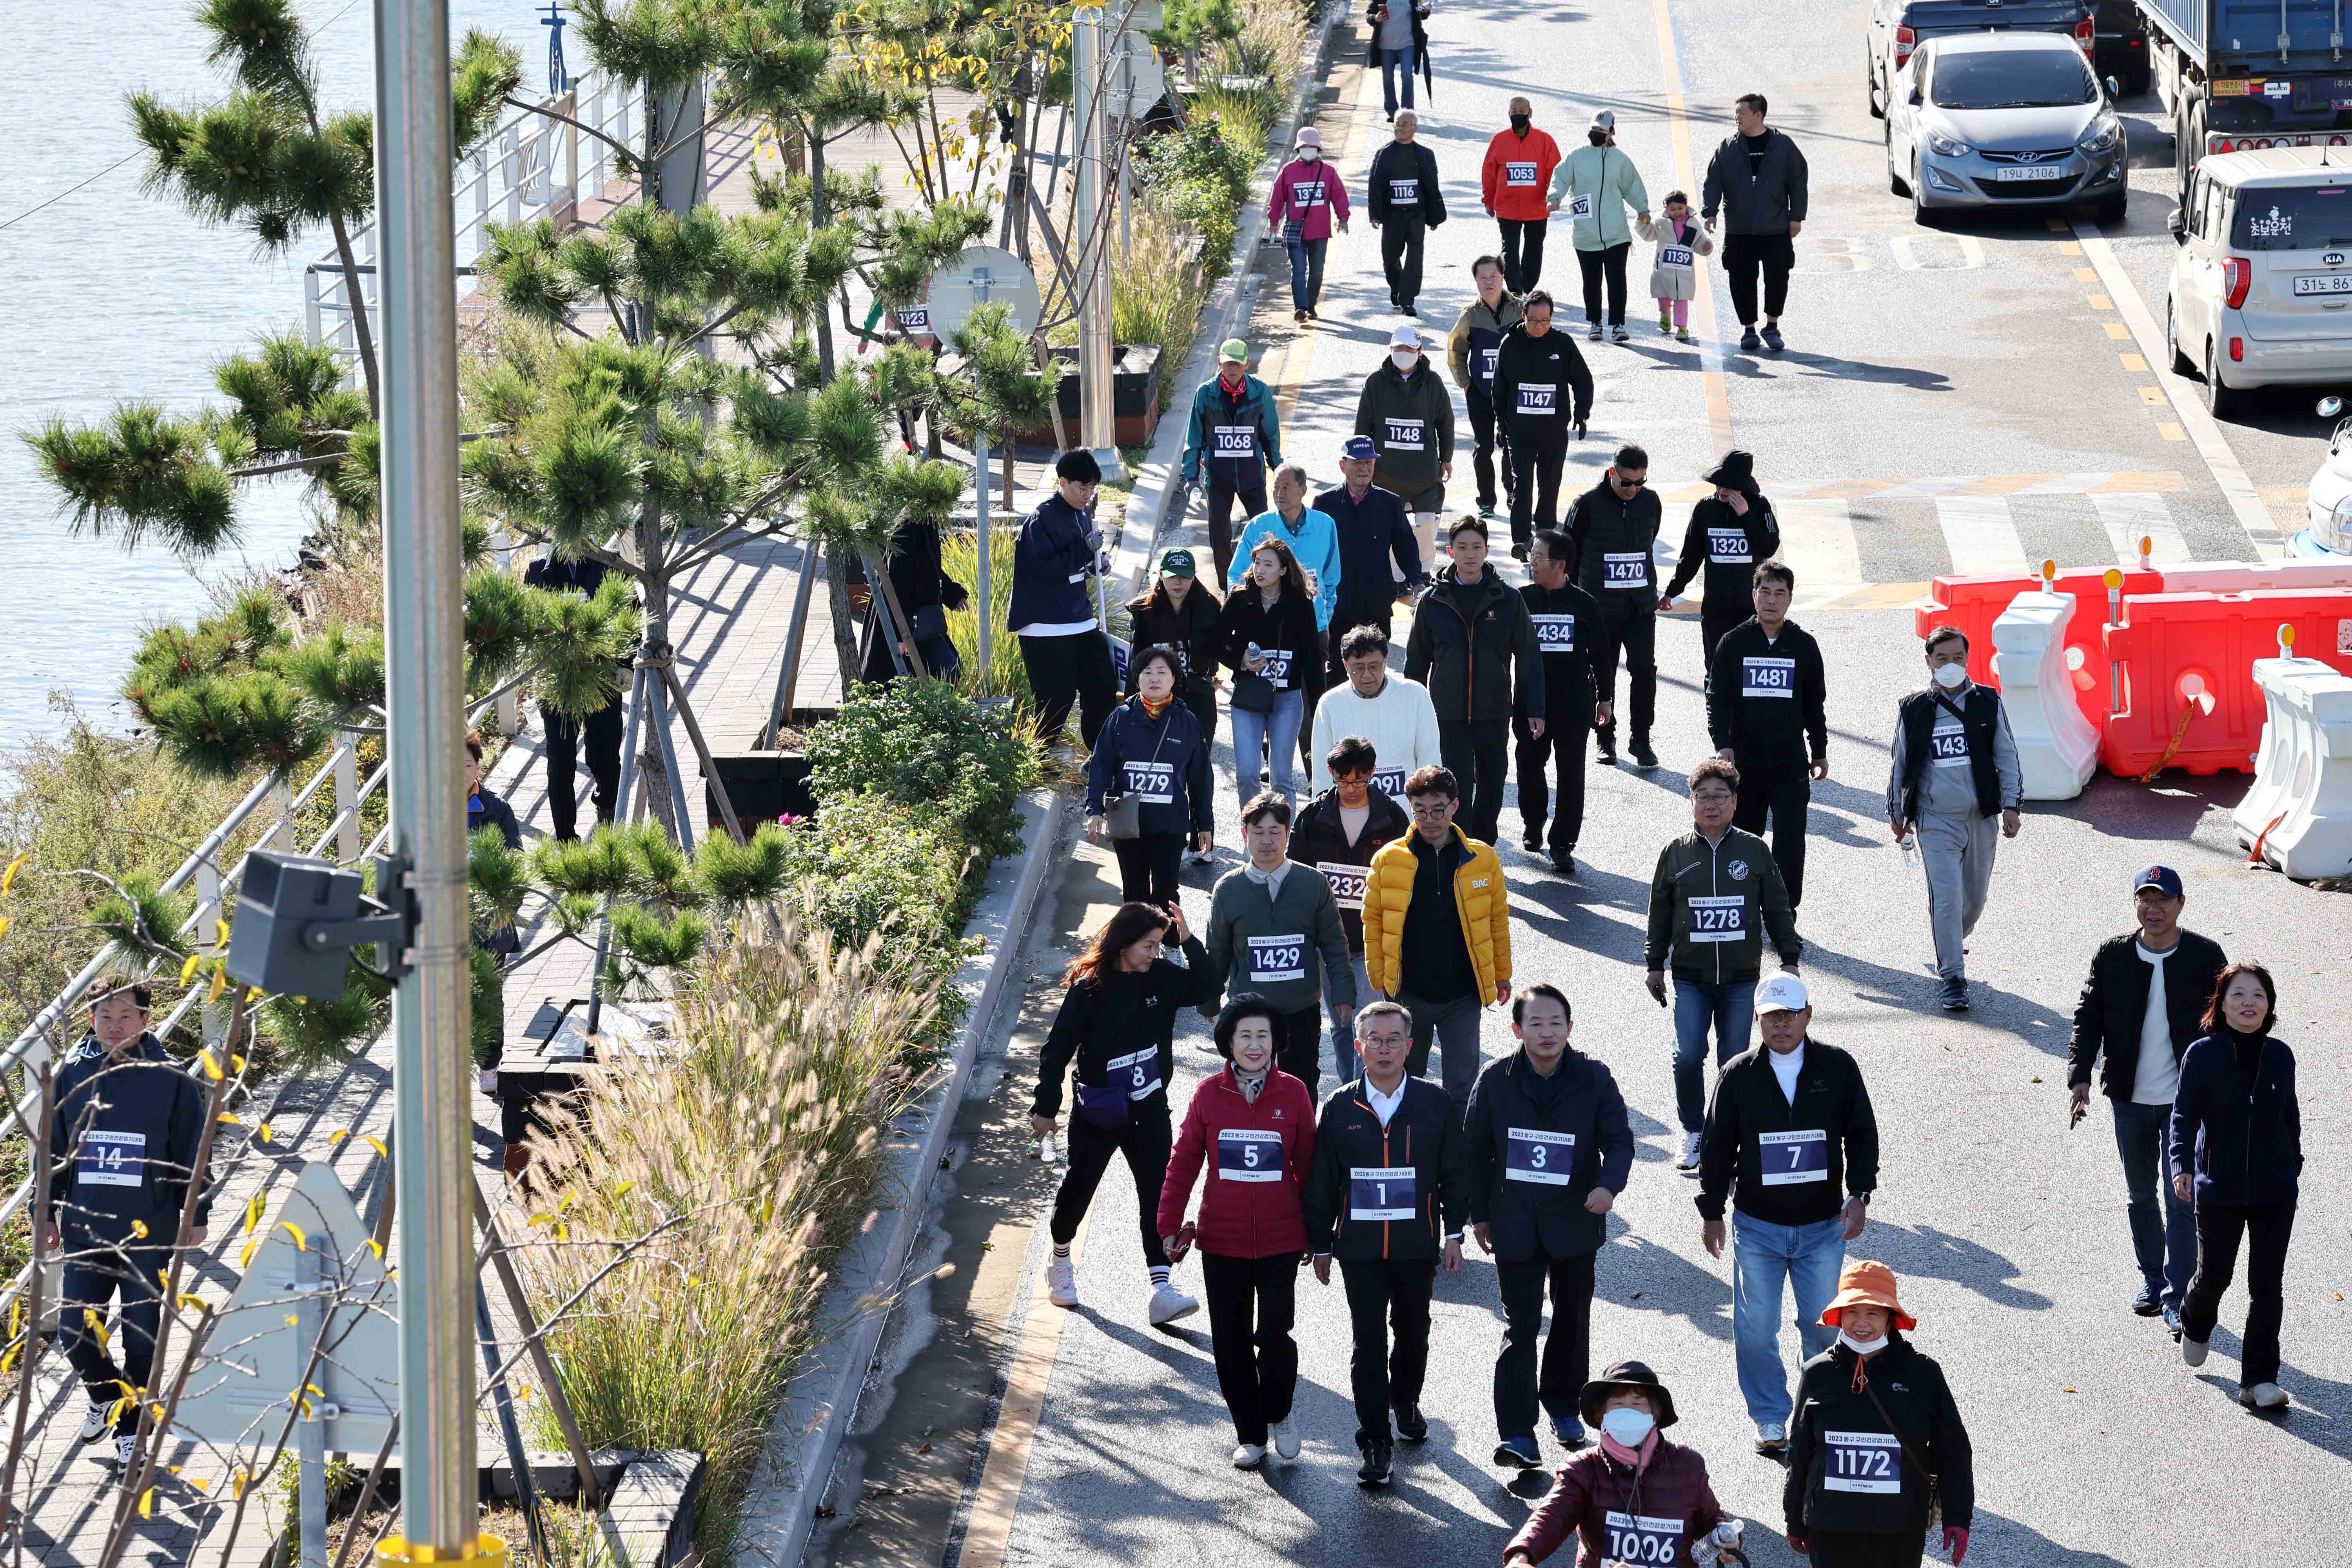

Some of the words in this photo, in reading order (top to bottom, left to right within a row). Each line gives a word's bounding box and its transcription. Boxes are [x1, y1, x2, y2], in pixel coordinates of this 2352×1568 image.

[1509, 169, 1534, 180] 1053
[2028, 168, 2054, 178] 2106
[1394, 187, 1414, 198] 1116
[2250, 221, 2291, 236] 초보운전
[1667, 251, 1690, 264] 1139
[2302, 279, 2326, 291] 31노
[2333, 278, 2352, 289] 86
[1523, 392, 1551, 406] 1147
[1218, 435, 1251, 448] 1068
[1390, 427, 1419, 441] 1148
[1711, 538, 1748, 554] 1320
[1609, 563, 1644, 579] 1470
[1534, 625, 1570, 641] 434
[1256, 659, 1287, 677] 239
[1749, 669, 1788, 687] 1481
[1933, 736, 1968, 755] 143
[1129, 773, 1169, 791] 1279
[1370, 775, 1399, 794] 091
[2148, 867, 2160, 880] B
[1325, 875, 1366, 897] 232
[1695, 909, 1740, 929] 1278
[1254, 947, 1299, 969] 1429
[1131, 1066, 1145, 1087] 8
[98, 1147, 122, 1170] 14
[1244, 1145, 1258, 1167] 5
[1532, 1145, 1546, 1168] 3
[1788, 1146, 1801, 1168] 7
[1377, 1183, 1385, 1205] 1
[1835, 1449, 1891, 1476] 1172
[1610, 1516, 1624, 1524] 2023
[1611, 1530, 1675, 1564] 1006
